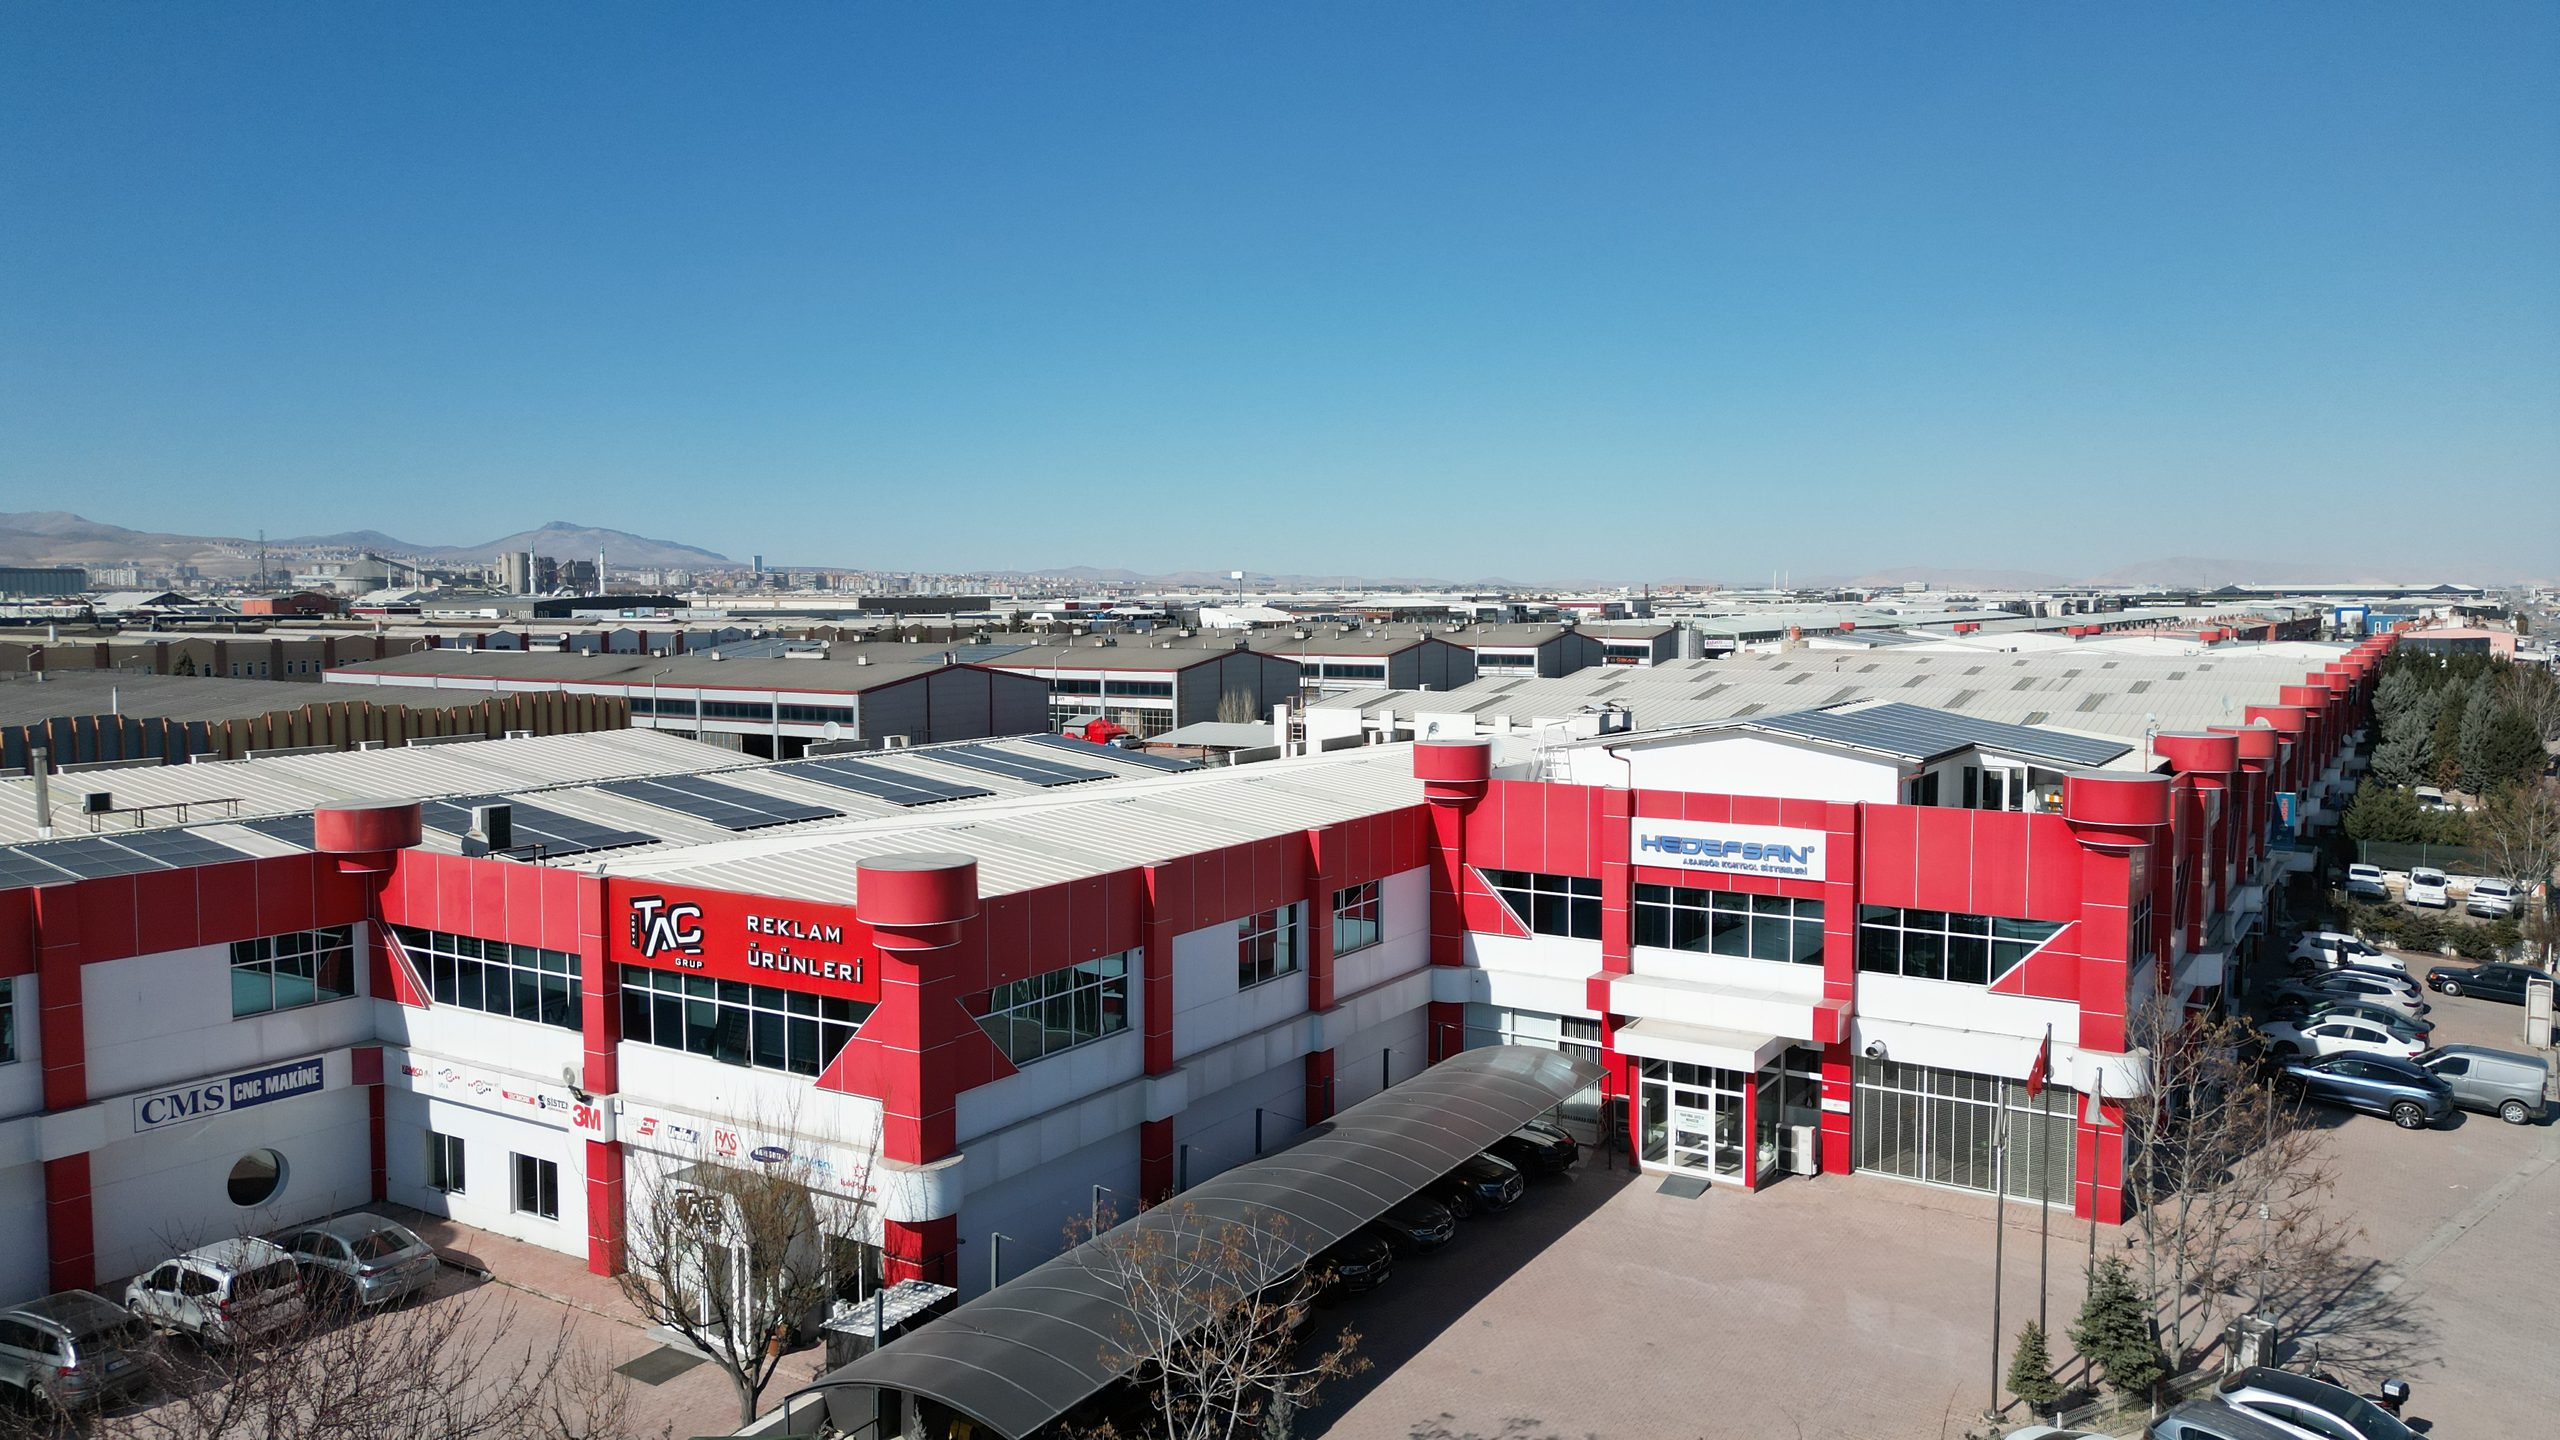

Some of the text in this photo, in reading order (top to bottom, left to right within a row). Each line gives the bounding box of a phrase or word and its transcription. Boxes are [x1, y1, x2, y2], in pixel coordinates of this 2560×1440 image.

[747, 915, 842, 944] REKLAM
[675, 957, 704, 969] GRUP
[747, 943, 863, 983] ÜRÜNLERİ
[141, 1066, 320, 1124] CMS CNC MAKİNE
[573, 1104, 602, 1131] 3M
